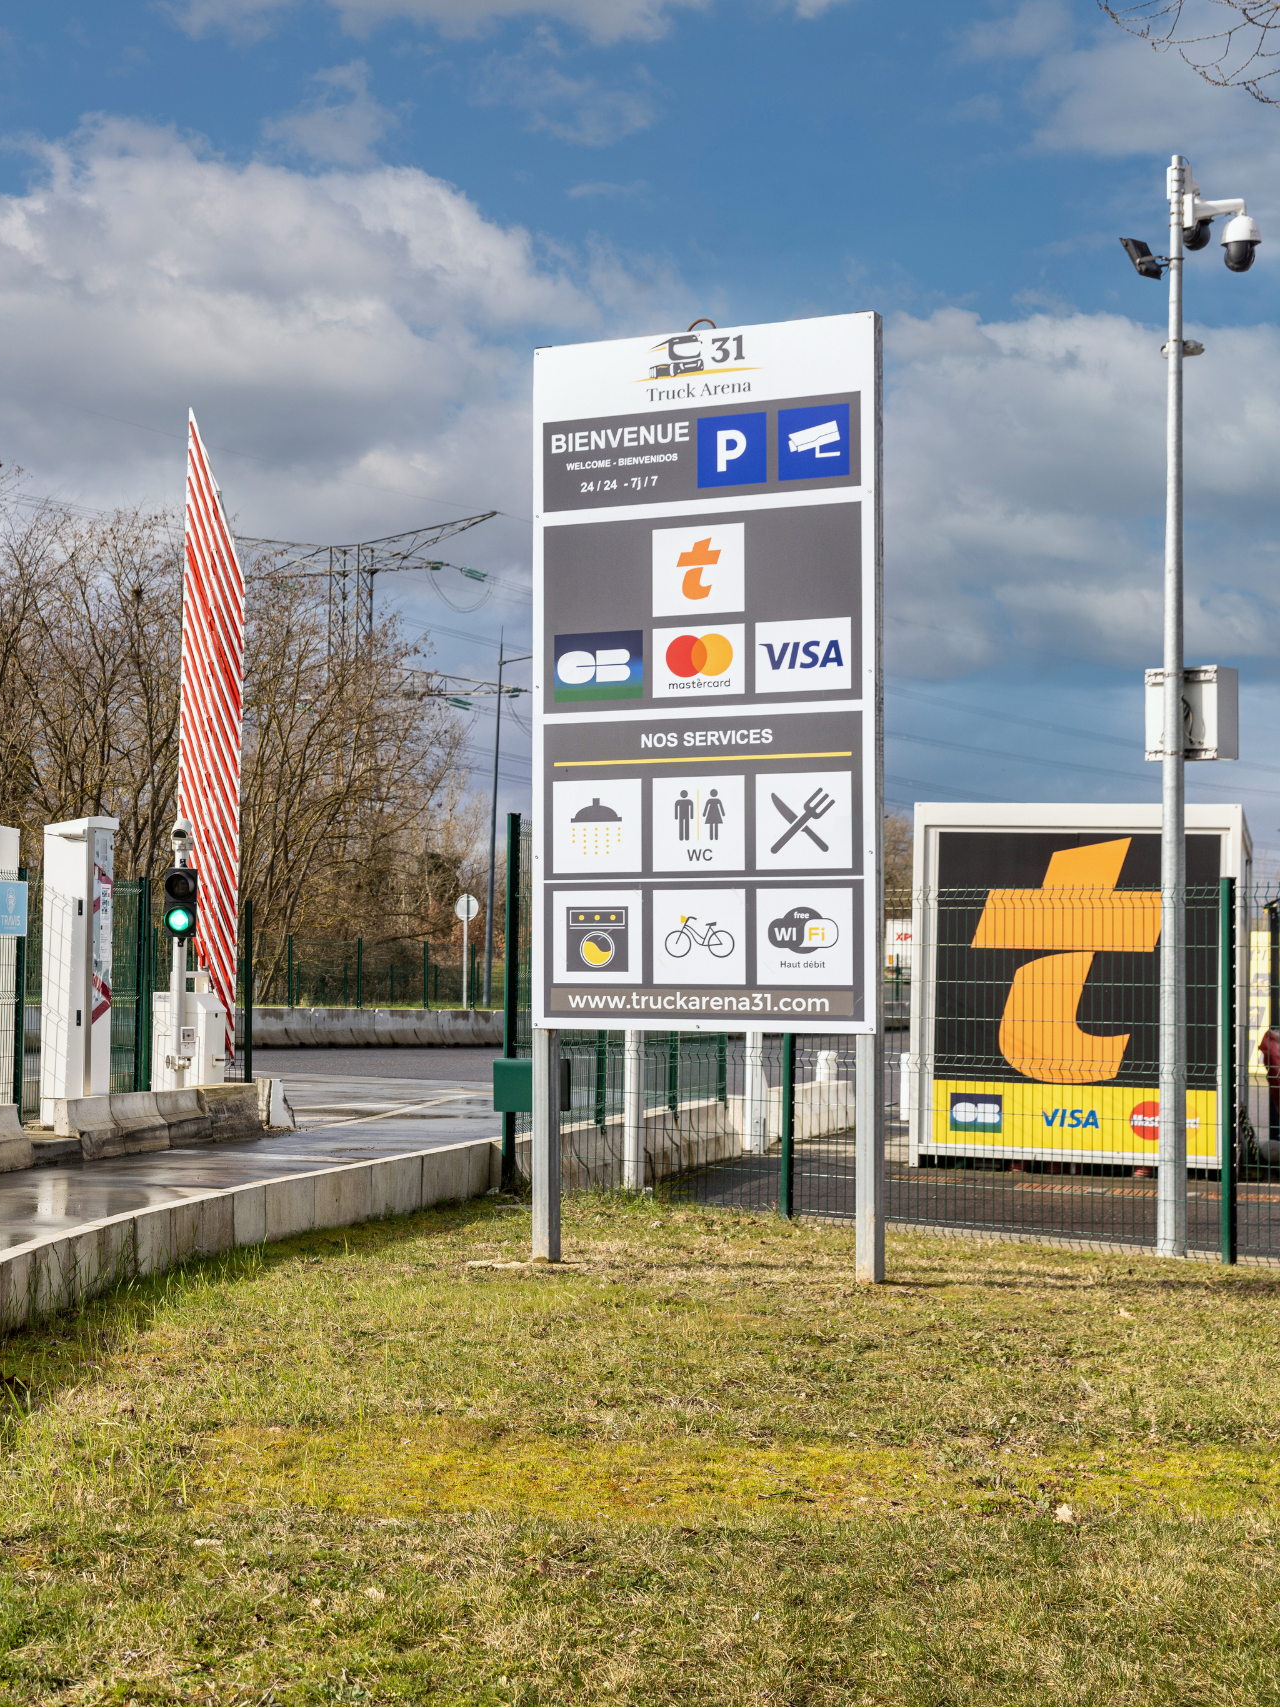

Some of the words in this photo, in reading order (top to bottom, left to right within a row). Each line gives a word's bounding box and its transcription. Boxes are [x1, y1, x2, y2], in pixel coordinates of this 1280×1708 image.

[709, 334, 747, 363] 31
[646, 383, 697, 402] Truck
[699, 379, 752, 397] Arena
[550, 420, 691, 455] BIENVENUE
[715, 428, 748, 473] P
[565, 458, 611, 472] WELCOME
[617, 452, 679, 467] BIENVENIDOS
[580, 480, 595, 493] 24
[603, 478, 618, 491] 24
[630, 477, 642, 491] 7j
[650, 475, 659, 488] 7
[758, 639, 844, 671] VISA
[668, 677, 731, 691] mastercard
[640, 731, 679, 749] NOS
[682, 728, 774, 746] SERVICES
[686, 848, 714, 862] WC
[793, 910, 810, 919] free
[773, 927, 797, 941] WI
[808, 927, 826, 941] Fi
[895, 932, 913, 942] XP
[780, 960, 801, 969] Haut
[803, 960, 826, 969] débit
[568, 991, 830, 1012] www.truckarena31.com
[1041, 1108, 1100, 1129] VISA
[1130, 1114, 1199, 1129] Mastrd
